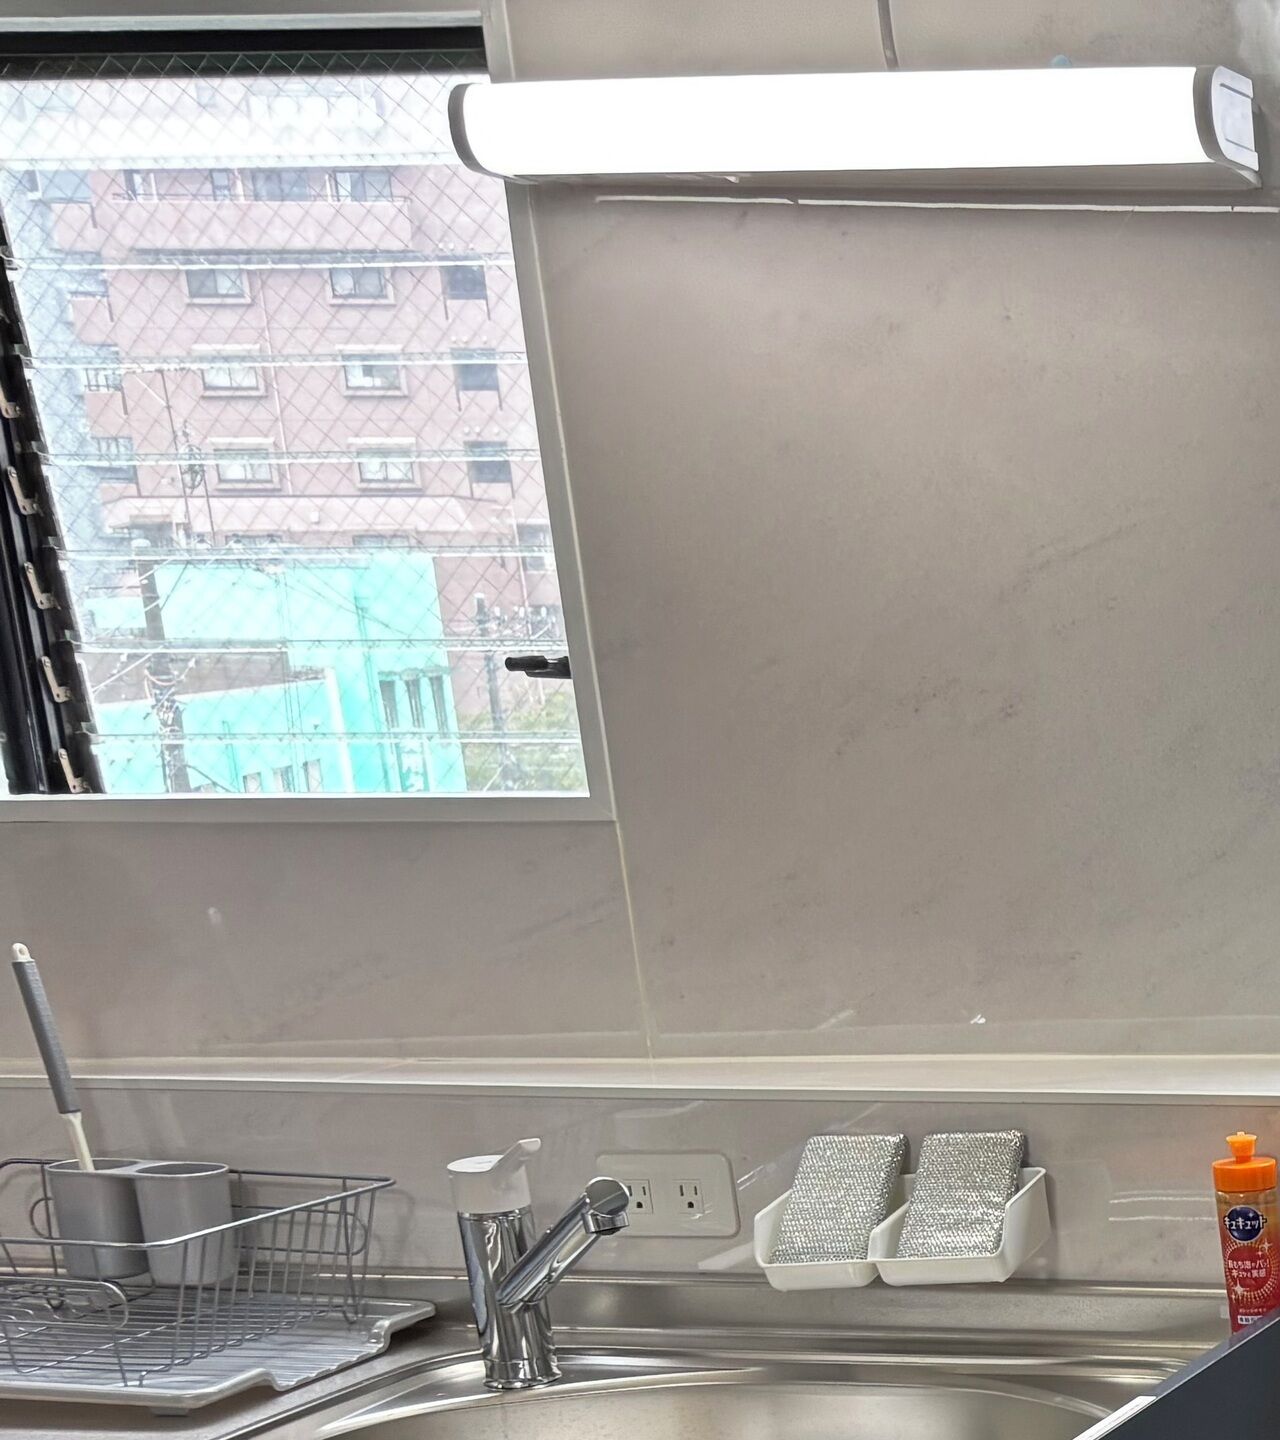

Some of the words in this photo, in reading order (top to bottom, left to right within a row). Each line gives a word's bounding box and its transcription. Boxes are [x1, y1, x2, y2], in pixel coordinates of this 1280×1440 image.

[1223, 1215, 1267, 1230] キュキュット
